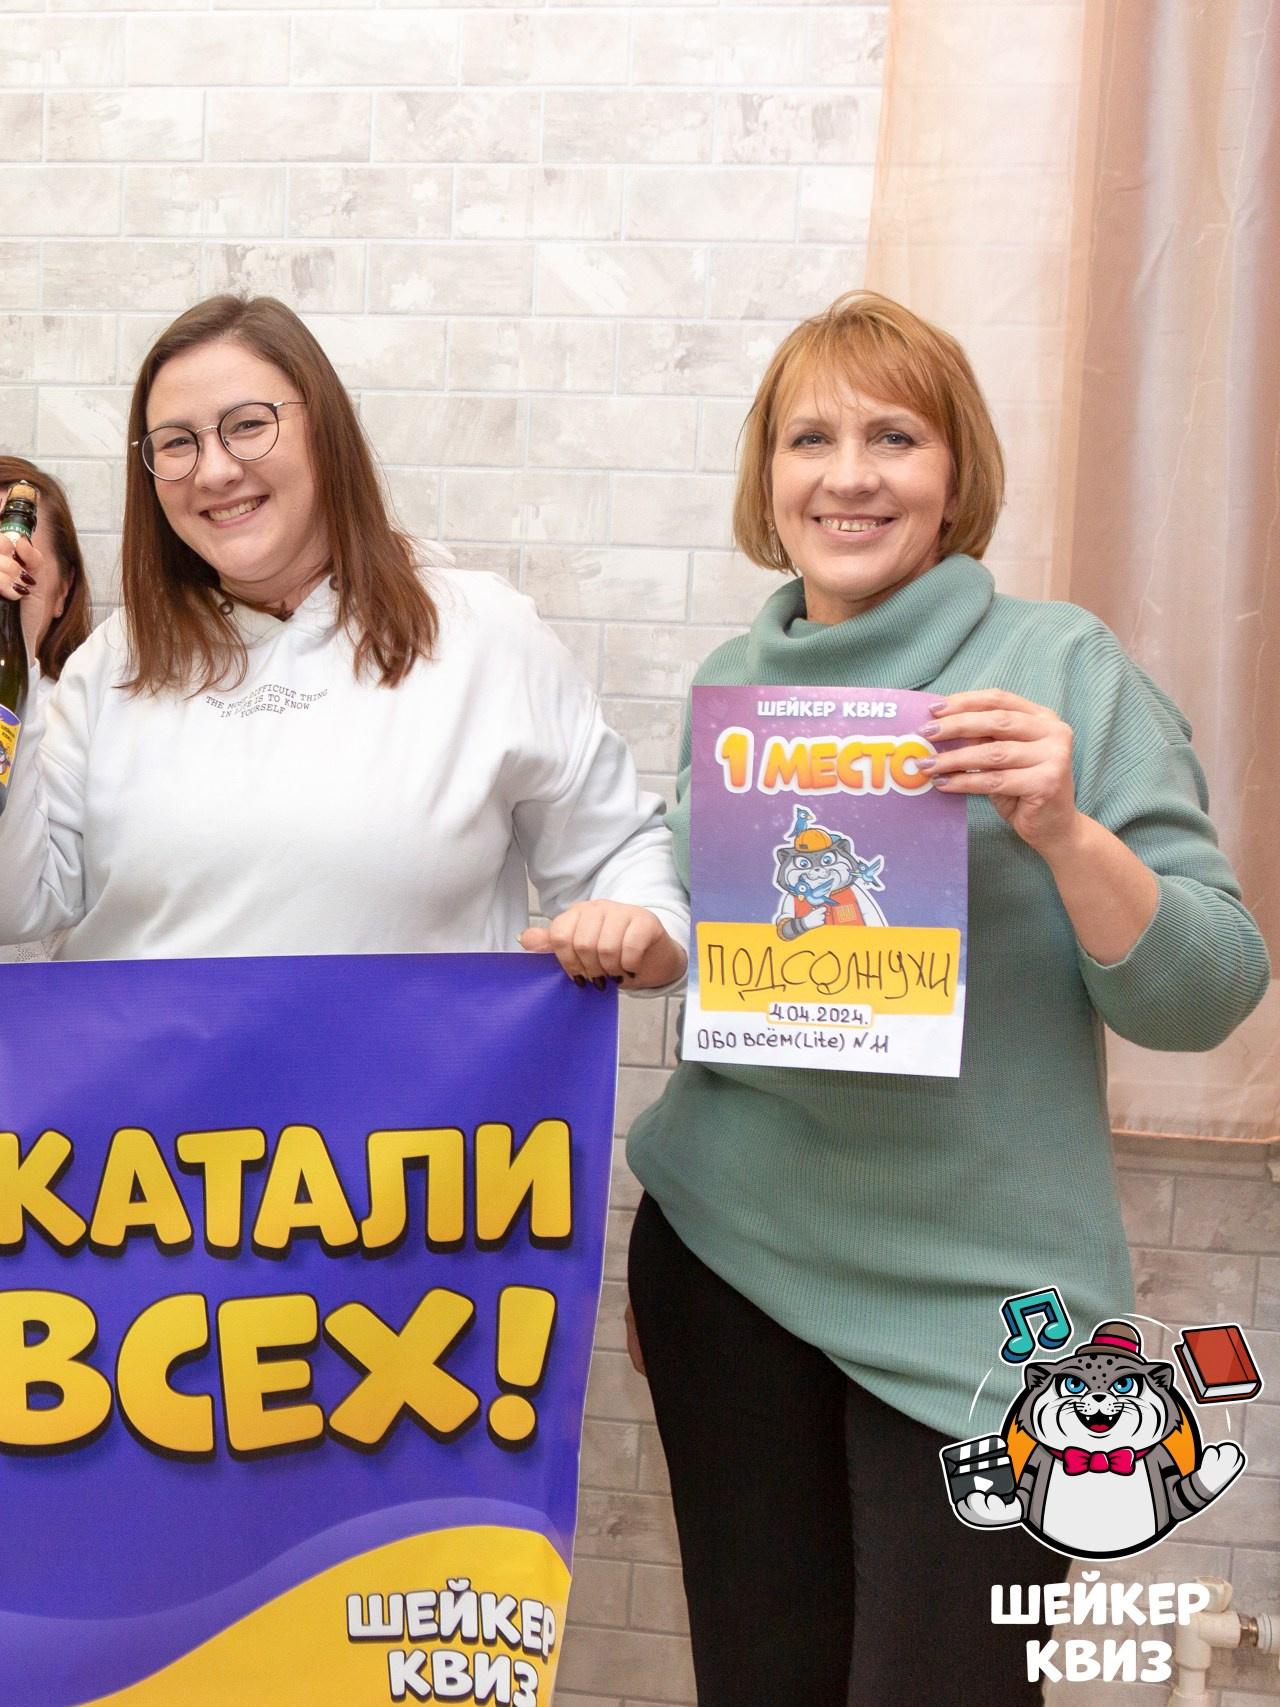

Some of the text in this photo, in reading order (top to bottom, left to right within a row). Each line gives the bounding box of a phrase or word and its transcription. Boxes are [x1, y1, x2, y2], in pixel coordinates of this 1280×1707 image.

[206, 684, 328, 710] THE MOST DIFFICULT THING
[240, 703, 286, 718] YOURSELF
[255, 695, 264, 704] IS
[268, 694, 281, 703] TO
[284, 698, 310, 710] KNOW
[757, 697, 898, 718] ШЕЙКЕР КВИЗ
[718, 730, 934, 792] 1 МЕСТО
[708, 944, 950, 1001] ПОДСОЛНУХИ
[347, 1577, 556, 1663] ШЕЙКЕР
[387, 1649, 539, 1707] КВИЗ
